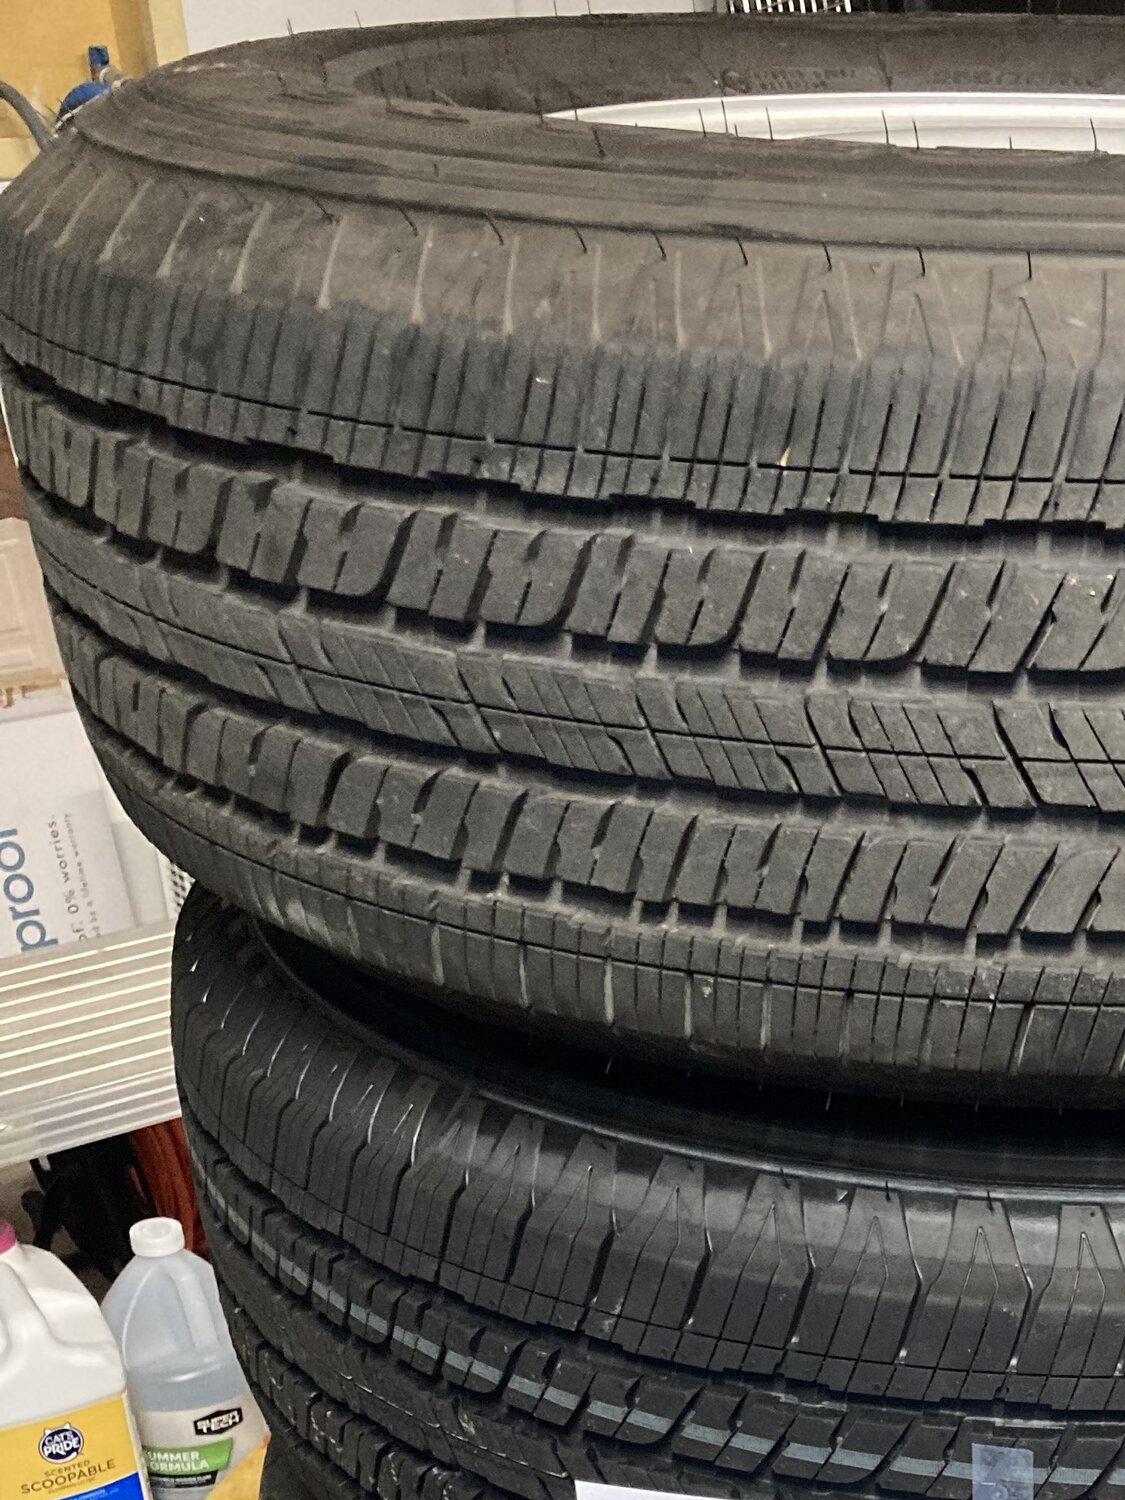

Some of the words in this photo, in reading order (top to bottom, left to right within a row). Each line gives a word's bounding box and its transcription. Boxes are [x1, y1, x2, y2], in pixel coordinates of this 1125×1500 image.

[43, 1436, 80, 1457] PRIDE
[143, 1451, 200, 1462] UMMER
[44, 1460, 91, 1477] SCENTED
[148, 1459, 209, 1472] ORMULA
[20, 1458, 117, 1495] SCOOPABLE
